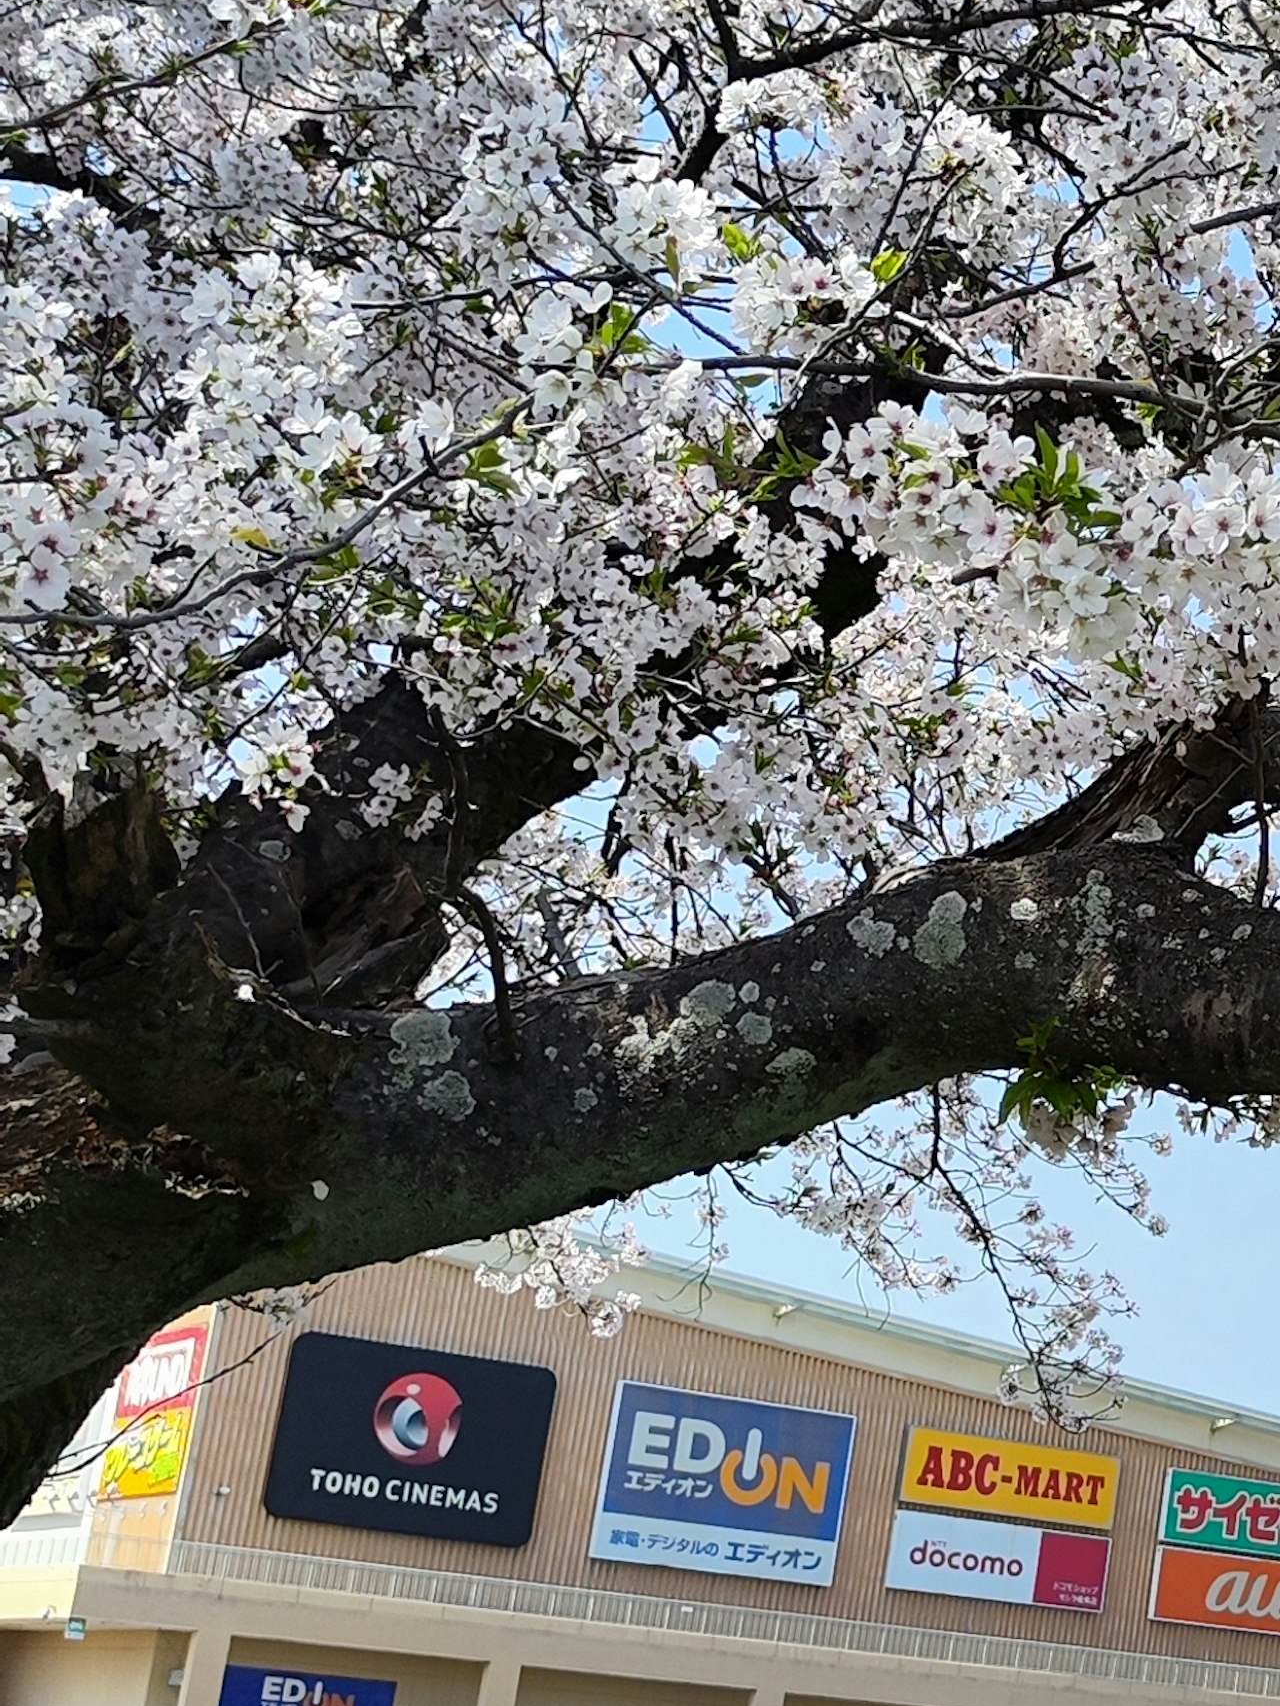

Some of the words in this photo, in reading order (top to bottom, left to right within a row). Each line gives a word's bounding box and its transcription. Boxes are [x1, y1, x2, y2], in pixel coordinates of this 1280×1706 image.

[623, 1470, 714, 1498] エディオン
[627, 1411, 831, 1514] EDION
[916, 1445, 1105, 1505] ABC-MART
[310, 1468, 380, 1498] TOHO
[385, 1479, 500, 1514] CINEMAS
[609, 1528, 719, 1557] 家電・デジタルの
[724, 1541, 822, 1571] エディオン
[909, 1539, 1023, 1577] docomo
